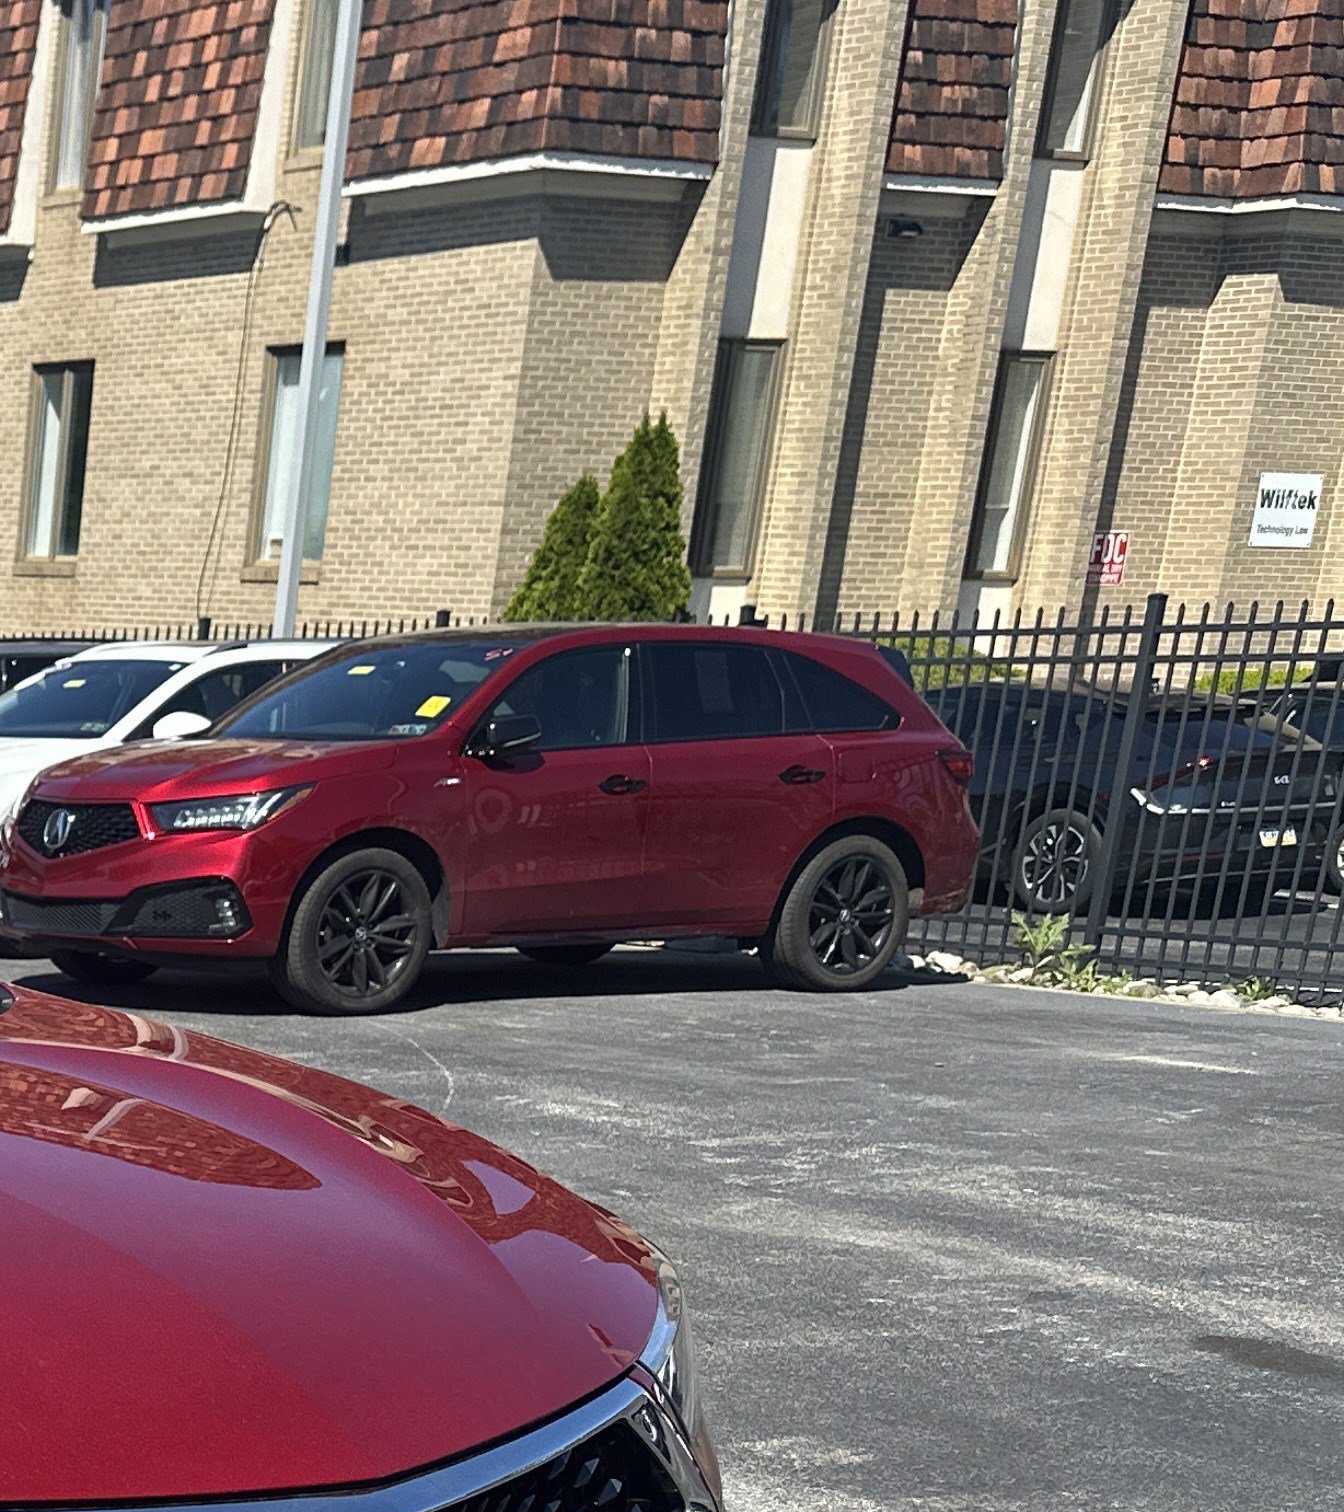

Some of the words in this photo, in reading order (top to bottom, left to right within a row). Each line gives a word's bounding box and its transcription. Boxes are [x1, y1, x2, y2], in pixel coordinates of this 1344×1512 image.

[1260, 488, 1318, 510] Wilftek
[1257, 524, 1294, 538] Technology
[1295, 526, 1309, 535] Law
[1089, 533, 1127, 564] FDC
